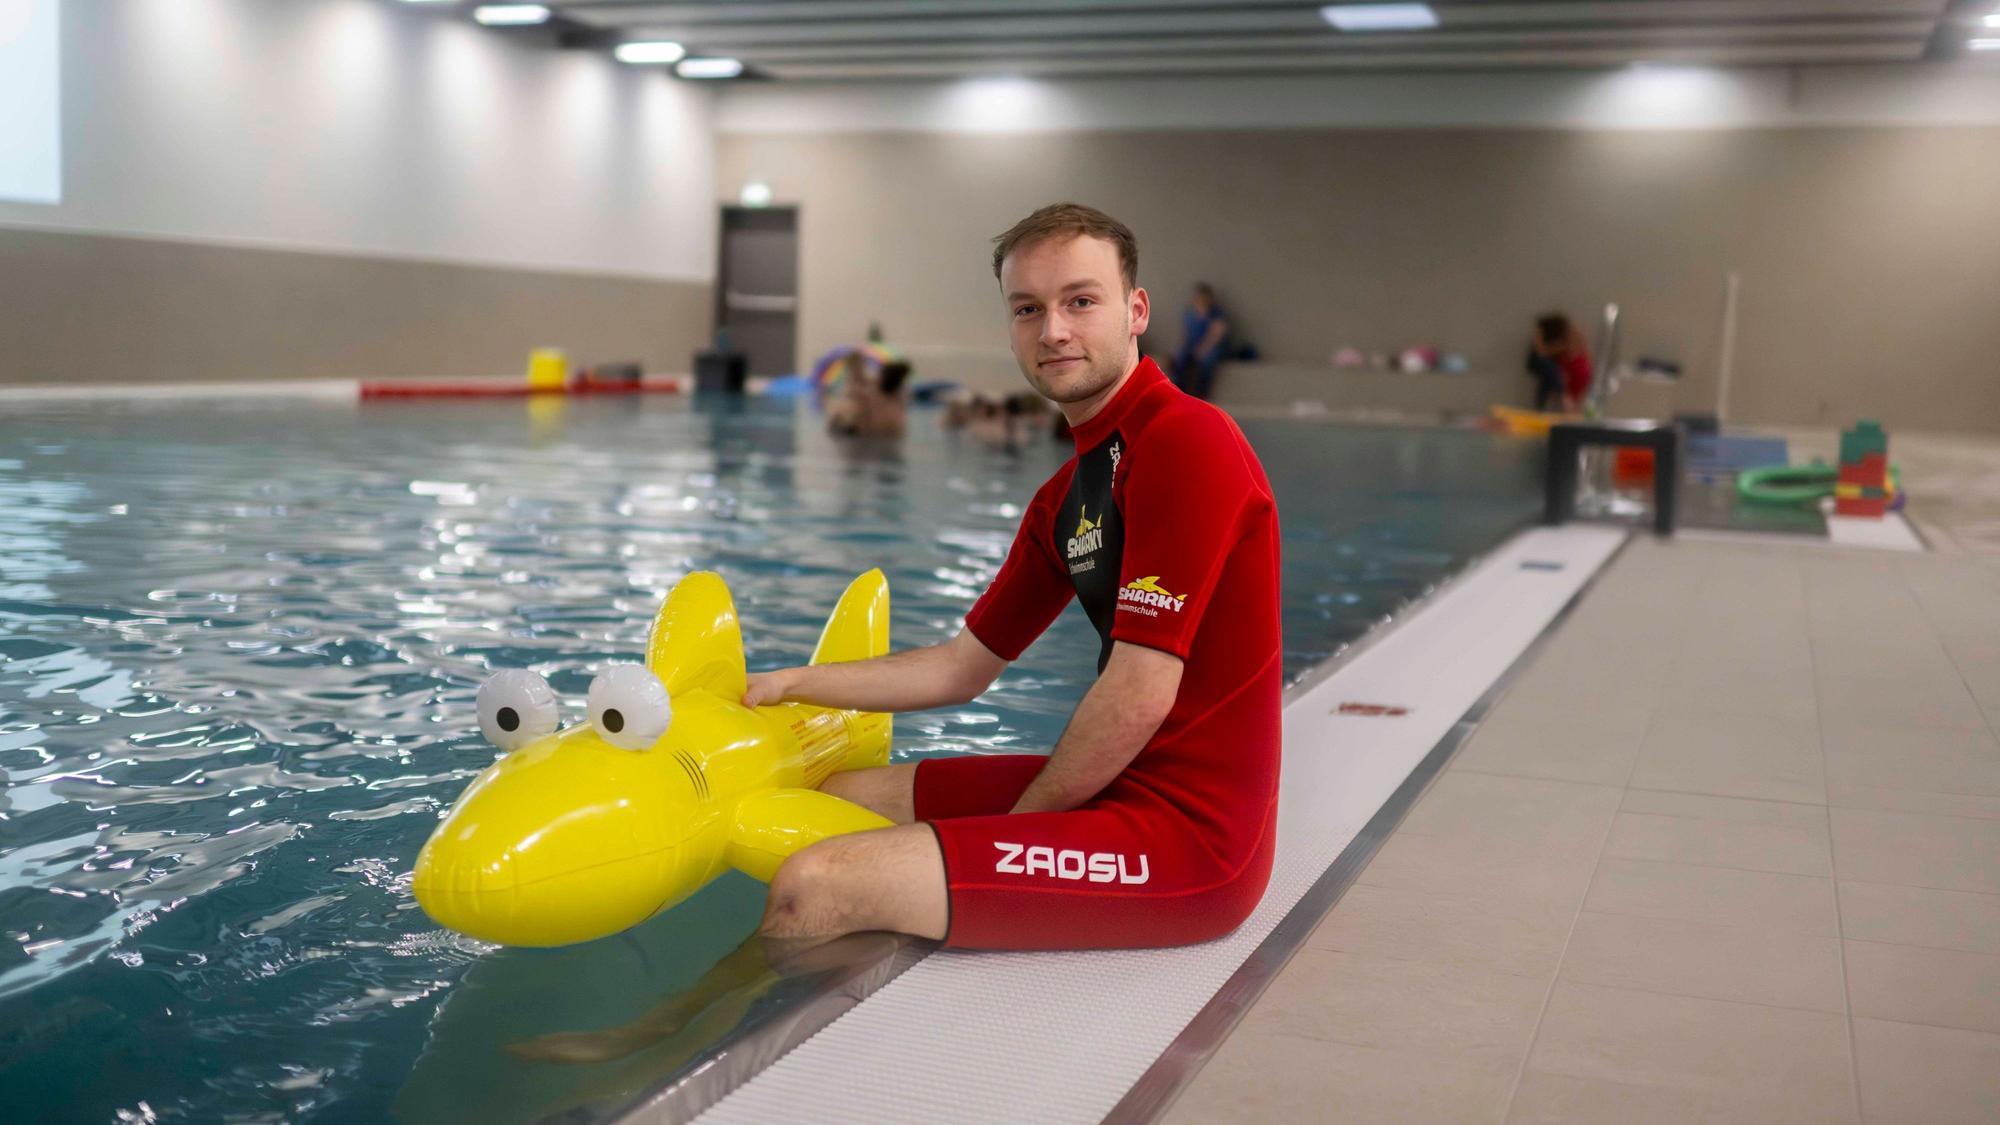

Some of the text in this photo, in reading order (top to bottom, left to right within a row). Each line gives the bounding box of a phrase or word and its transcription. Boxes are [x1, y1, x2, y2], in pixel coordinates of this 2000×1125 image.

[1067, 528, 1103, 559] SHARKY
[1118, 587, 1185, 613] SHARKY
[993, 841, 1150, 885] ZAOSU
